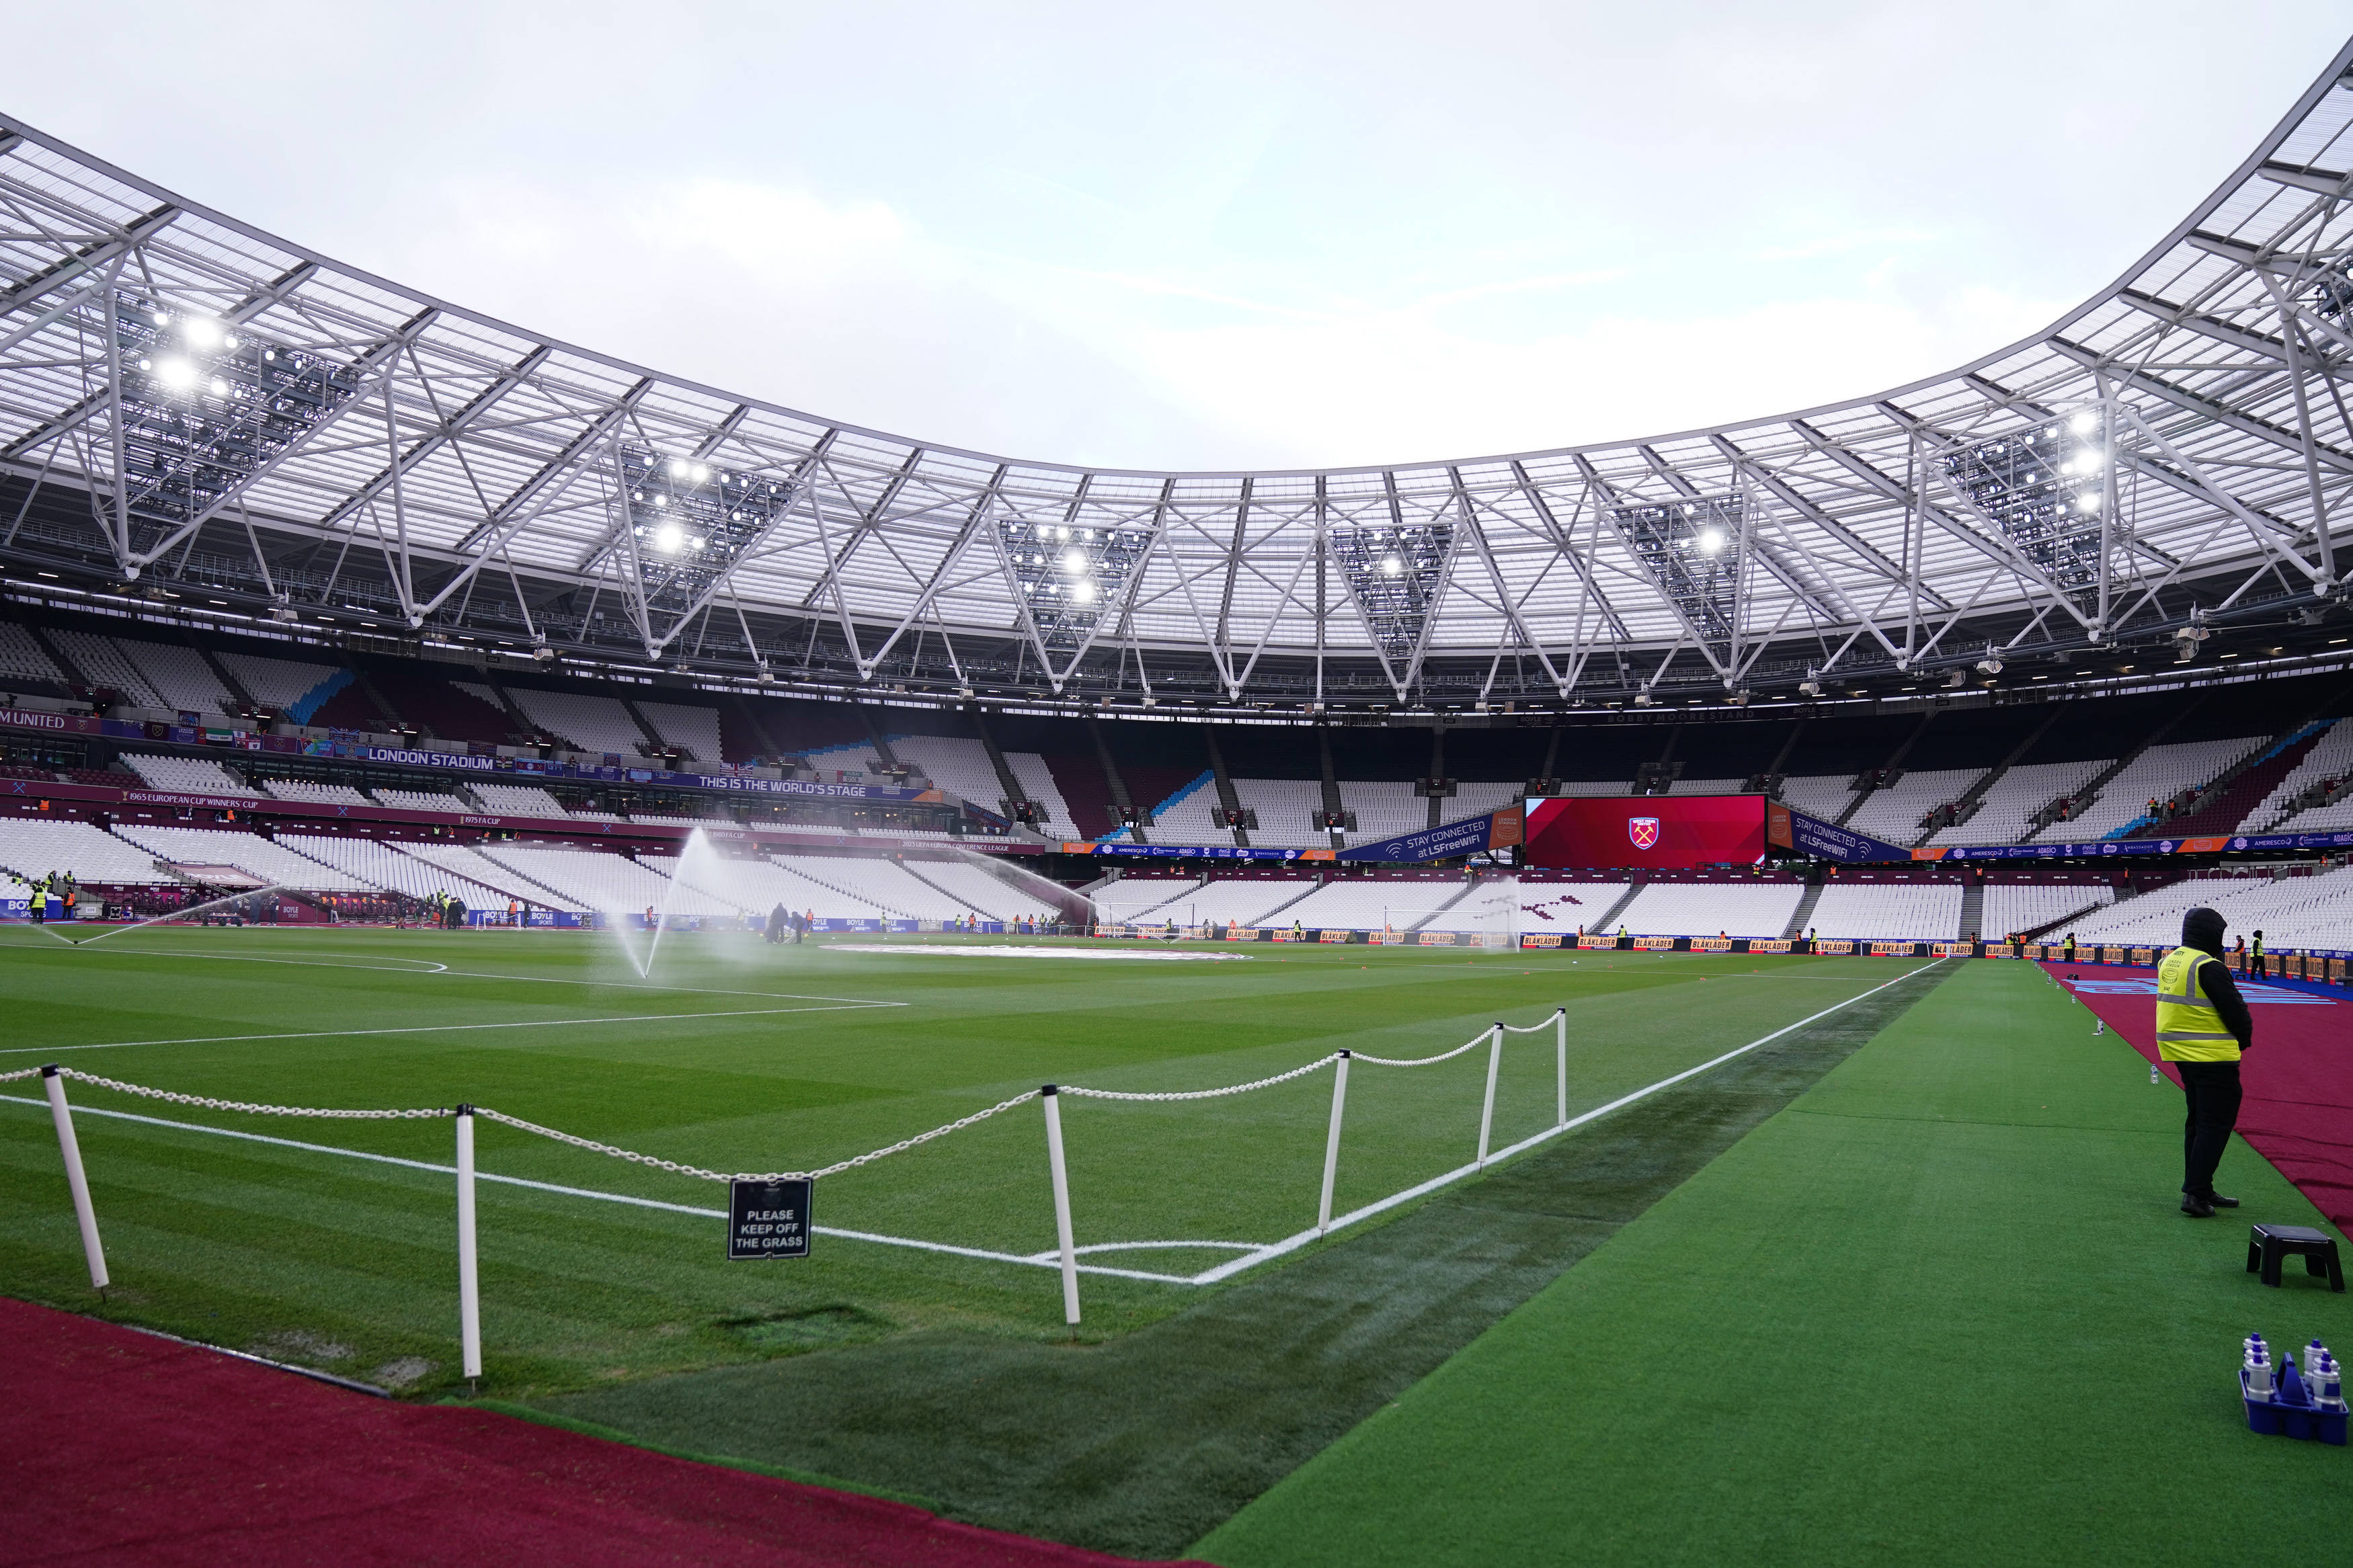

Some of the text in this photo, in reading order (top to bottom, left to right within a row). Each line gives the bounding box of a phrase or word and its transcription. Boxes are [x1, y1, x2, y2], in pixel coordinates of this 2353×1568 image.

[13, 712, 65, 729] UNITED
[1608, 710, 1754, 723] BOBBY MOORE STAND
[369, 748, 493, 770] LONDON STADIUM
[699, 776, 867, 797] THIS IS THE WORLD'S STAGE
[130, 792, 259, 809] 1965 EUROPEAN CUP WINNERS' CUP
[1407, 821, 1485, 849] STAY CONNECTED
[1796, 817, 1856, 848] STAY CONNECTED
[1800, 833, 1807, 843] at
[1418, 849, 1428, 858] at
[2038, 845, 2057, 854] ADAGIO
[532, 912, 553, 920] BOYLE
[747, 1210, 794, 1221] PLEASE
[741, 1223, 799, 1235] KEEP OFF
[735, 1236, 803, 1249] THE GRASS
